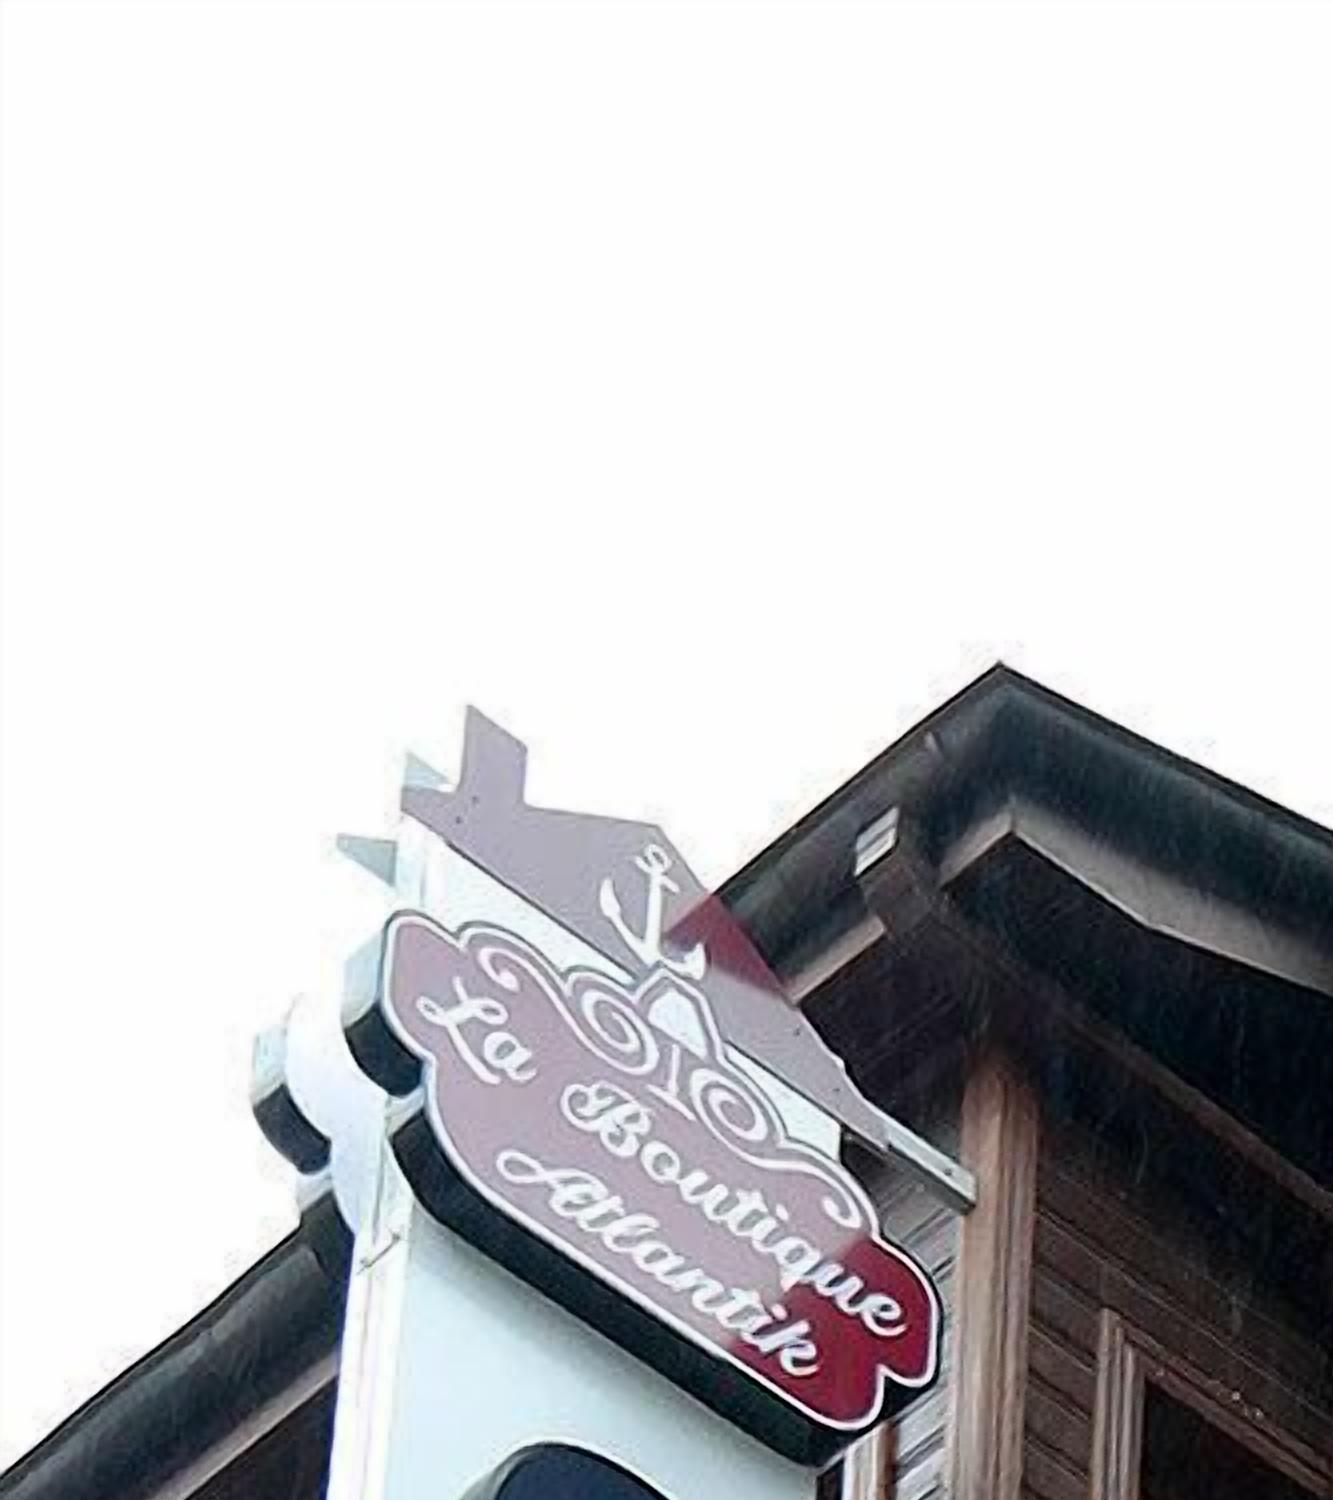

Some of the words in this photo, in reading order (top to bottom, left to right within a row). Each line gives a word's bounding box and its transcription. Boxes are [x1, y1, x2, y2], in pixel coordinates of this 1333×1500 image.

[418, 976, 538, 1085] La
[562, 1082, 906, 1337] Boutique
[497, 1151, 821, 1376] Atlantik
